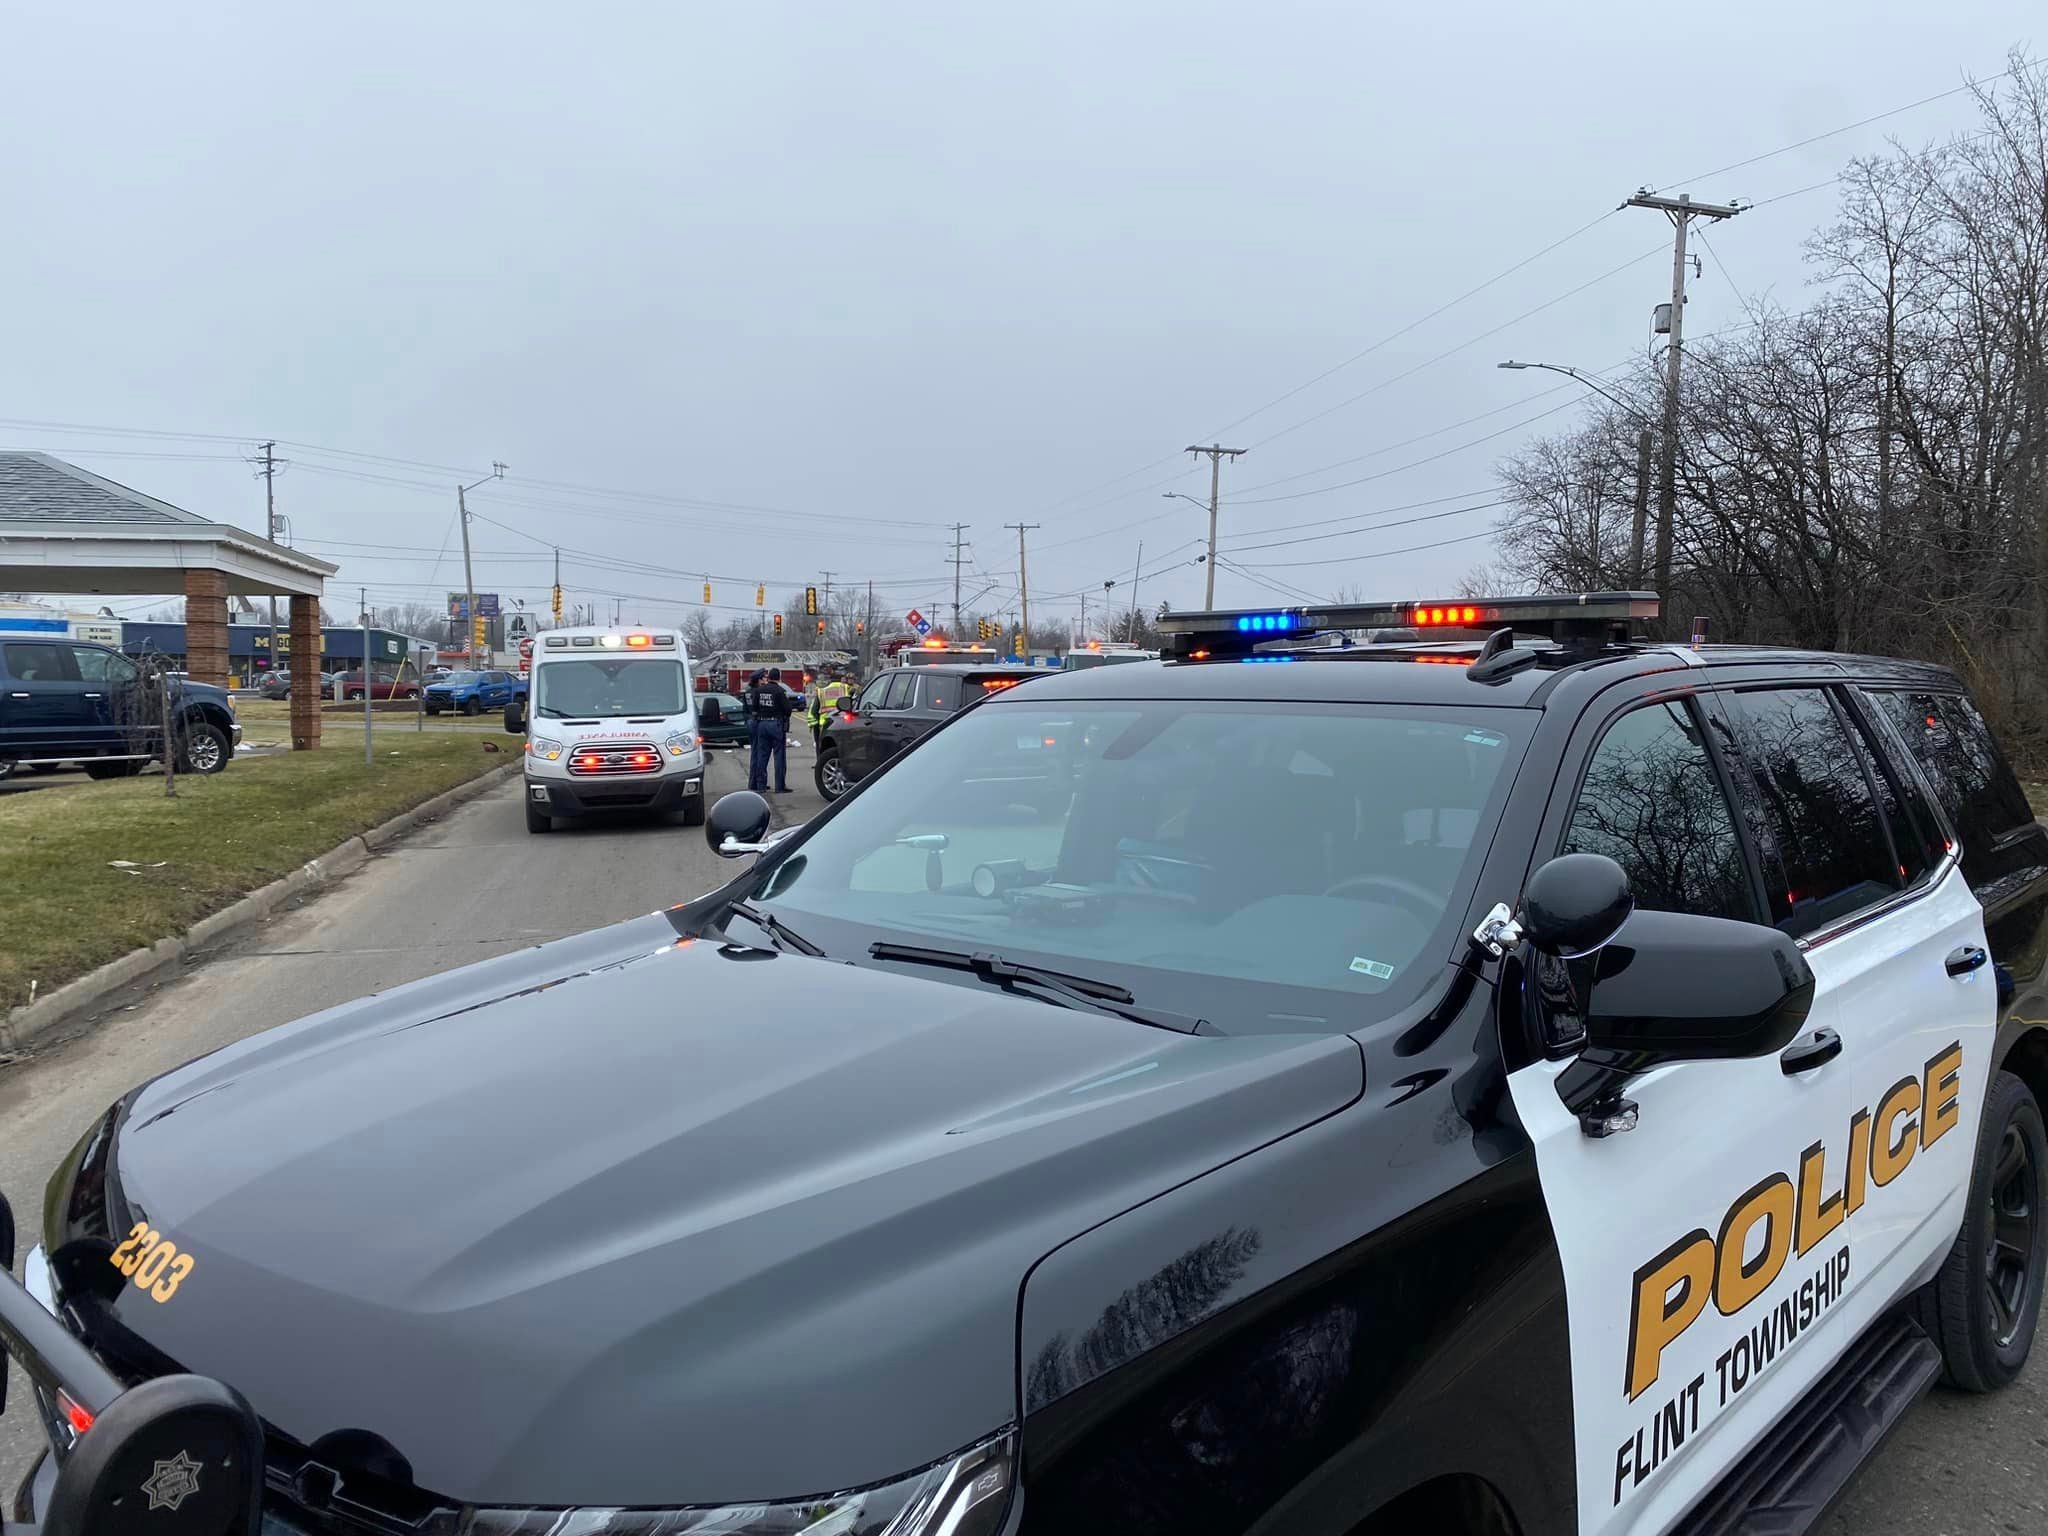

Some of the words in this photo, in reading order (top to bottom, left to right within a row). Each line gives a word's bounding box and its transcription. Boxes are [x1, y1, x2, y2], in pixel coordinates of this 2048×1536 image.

[254, 636, 270, 648] M
[110, 1222, 195, 1303] 2303
[1623, 1040, 1963, 1405] POLICE
[1613, 1373, 1705, 1508] FLINT
[1715, 1245, 1851, 1408] TOWNSHIP
